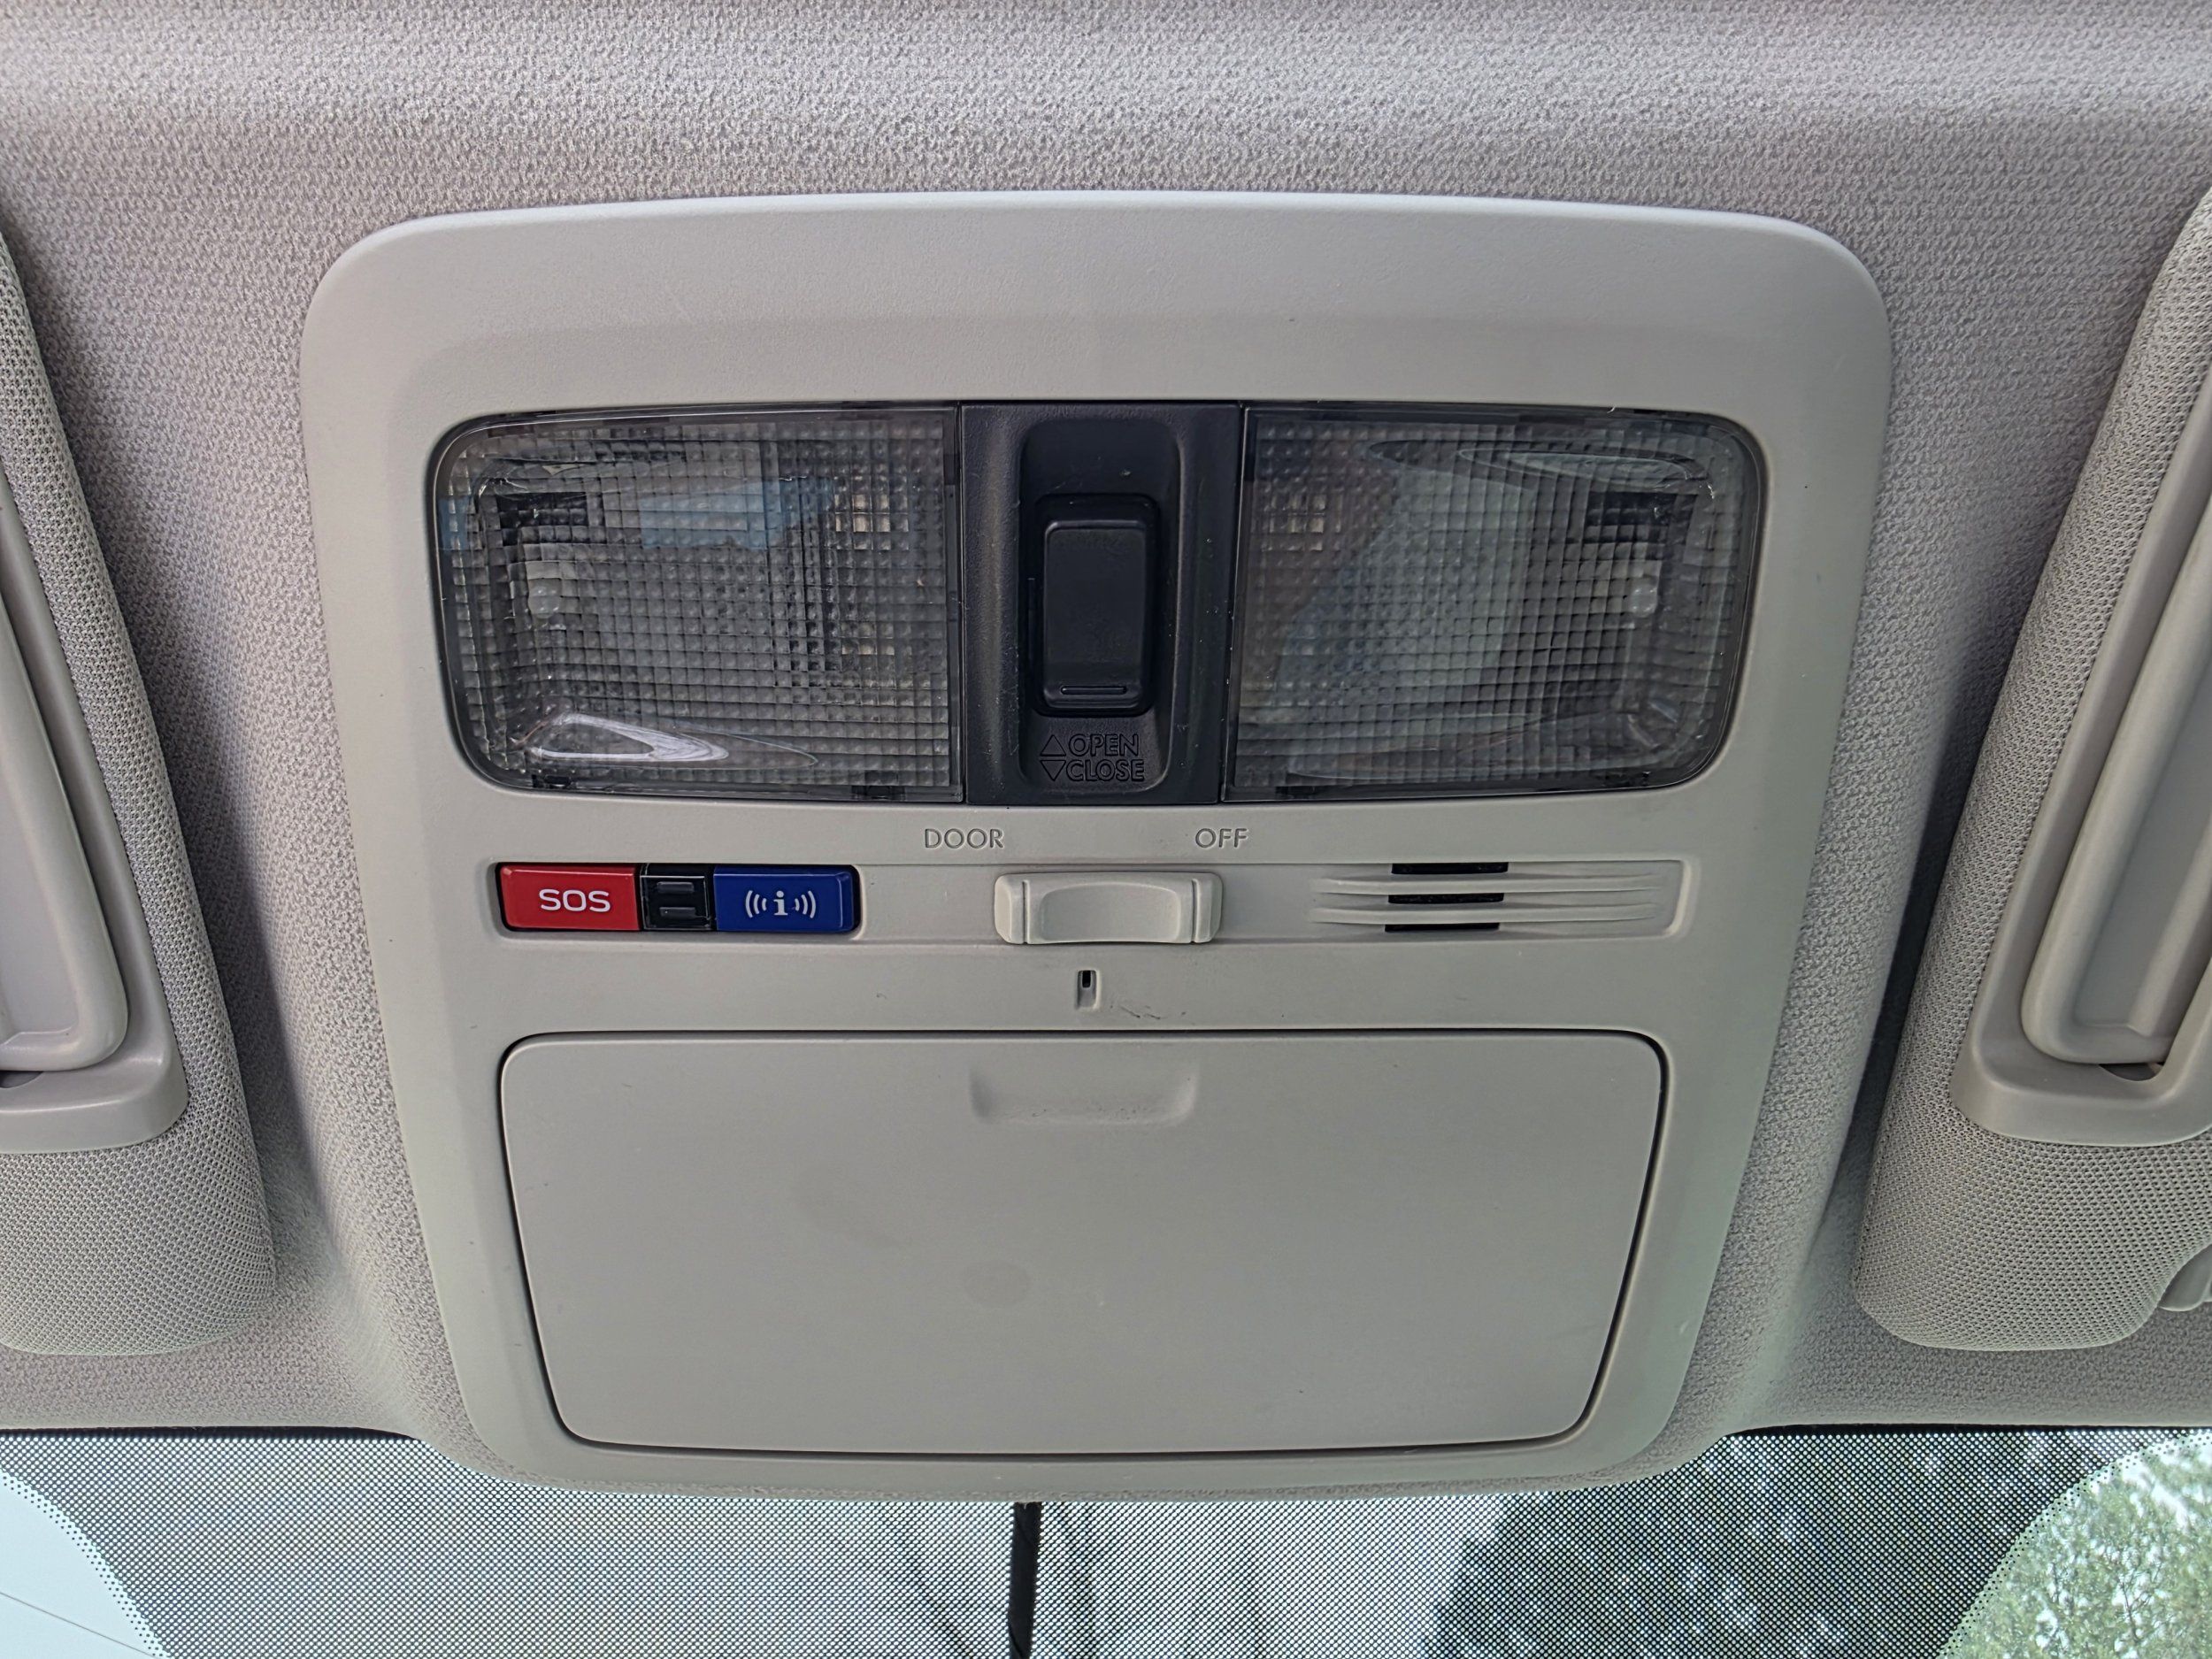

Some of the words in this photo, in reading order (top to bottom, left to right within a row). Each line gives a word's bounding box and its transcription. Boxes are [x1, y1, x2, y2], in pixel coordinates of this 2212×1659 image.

[1068, 733, 1139, 757] OPEN
[1066, 758, 1144, 782] CLOSE
[925, 828, 1004, 849] DOOR
[1195, 828, 1248, 849] OFF
[539, 888, 611, 913] SOS
